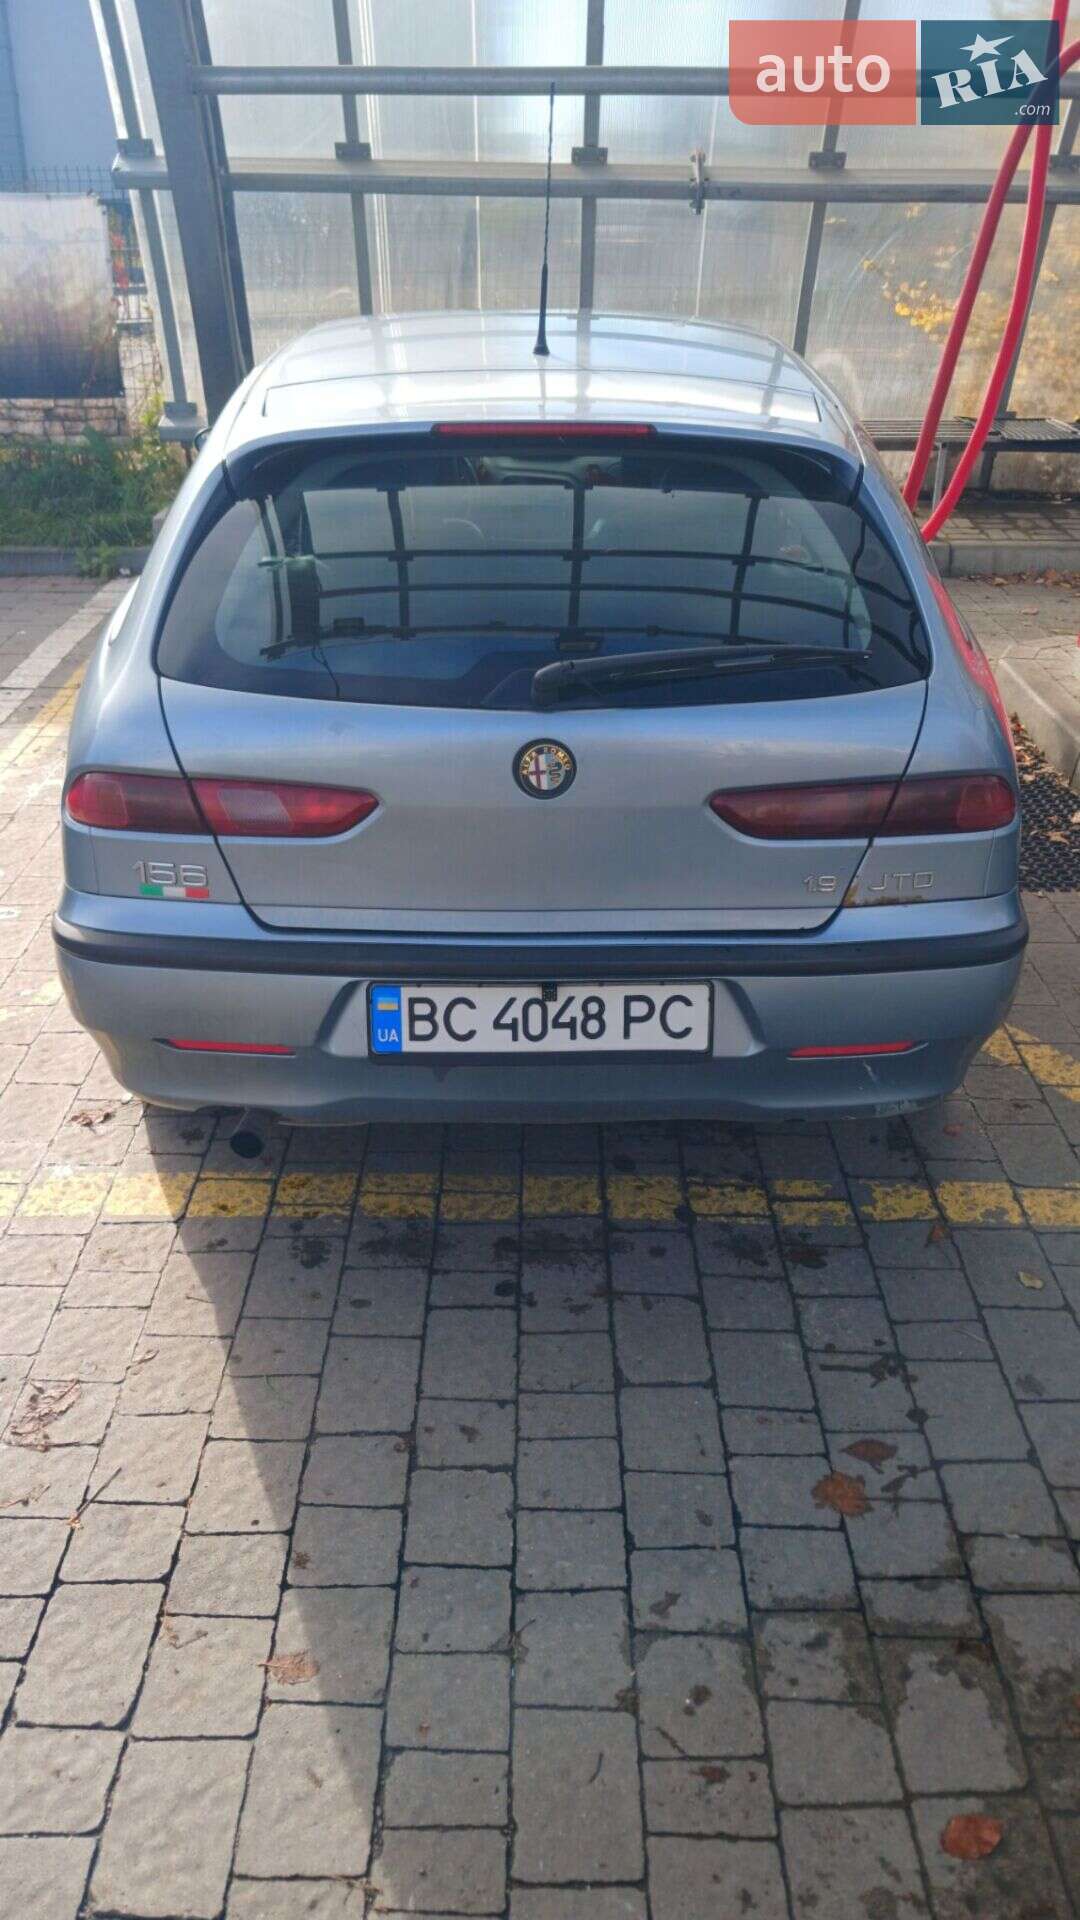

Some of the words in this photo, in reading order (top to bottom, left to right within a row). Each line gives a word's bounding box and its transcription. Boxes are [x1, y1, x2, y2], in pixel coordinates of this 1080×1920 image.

[133, 861, 207, 887] 156
[869, 872, 936, 891] JTD
[407, 997, 477, 1042] BC
[492, 995, 606, 1042] 4048
[623, 994, 693, 1040] PC
[377, 1028, 399, 1043] UA
